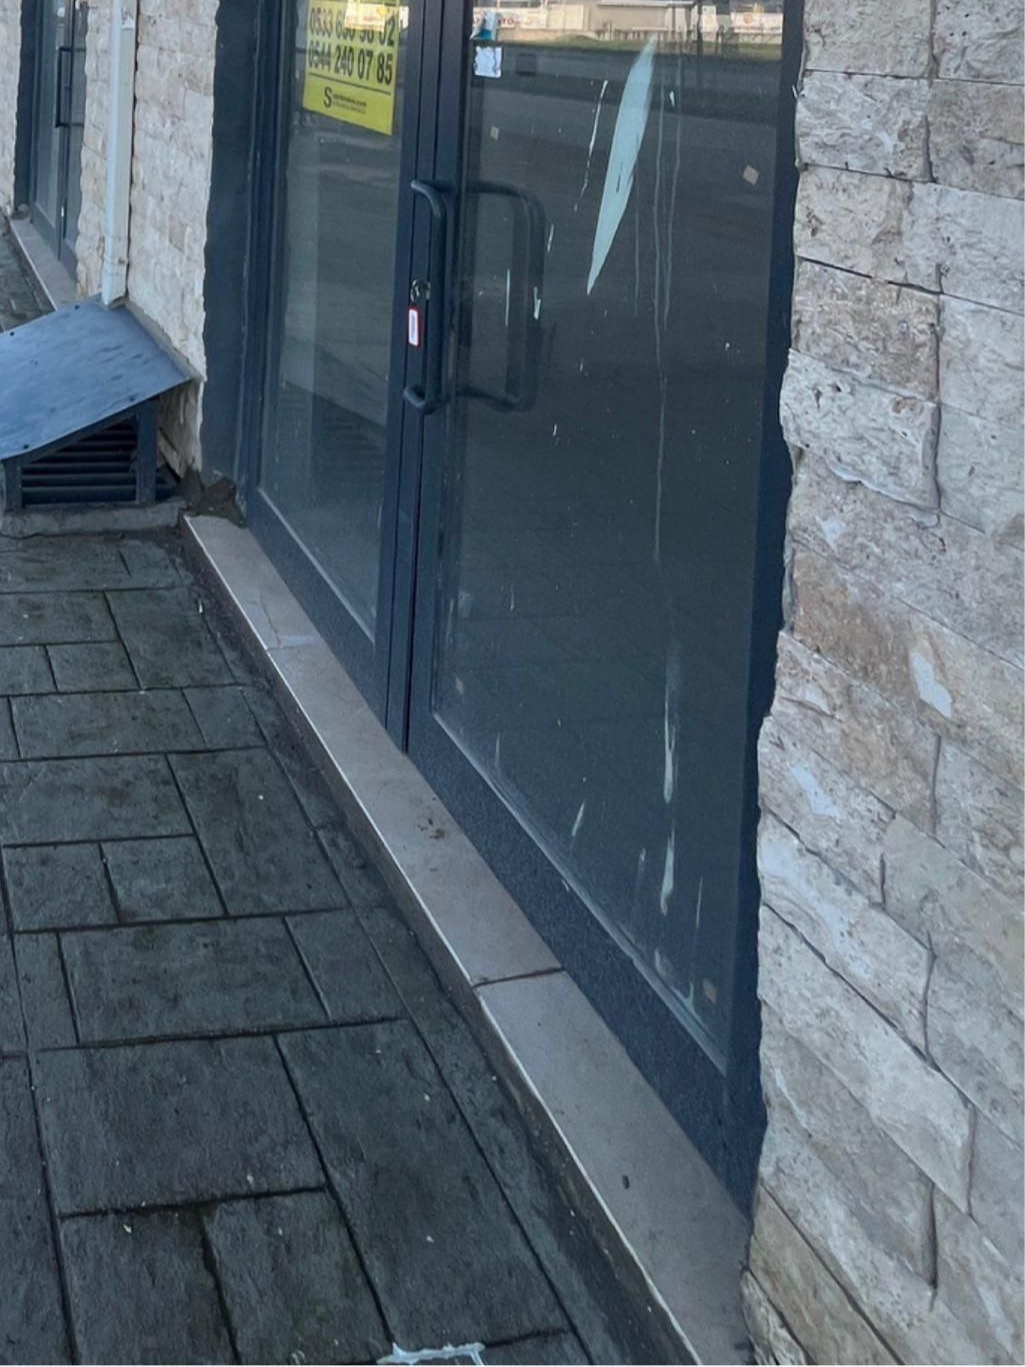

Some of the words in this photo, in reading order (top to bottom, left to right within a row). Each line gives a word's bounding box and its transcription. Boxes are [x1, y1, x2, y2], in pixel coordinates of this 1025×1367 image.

[335, 44, 355, 77] 240
[358, 48, 374, 81] 07
[377, 52, 394, 86] 85
